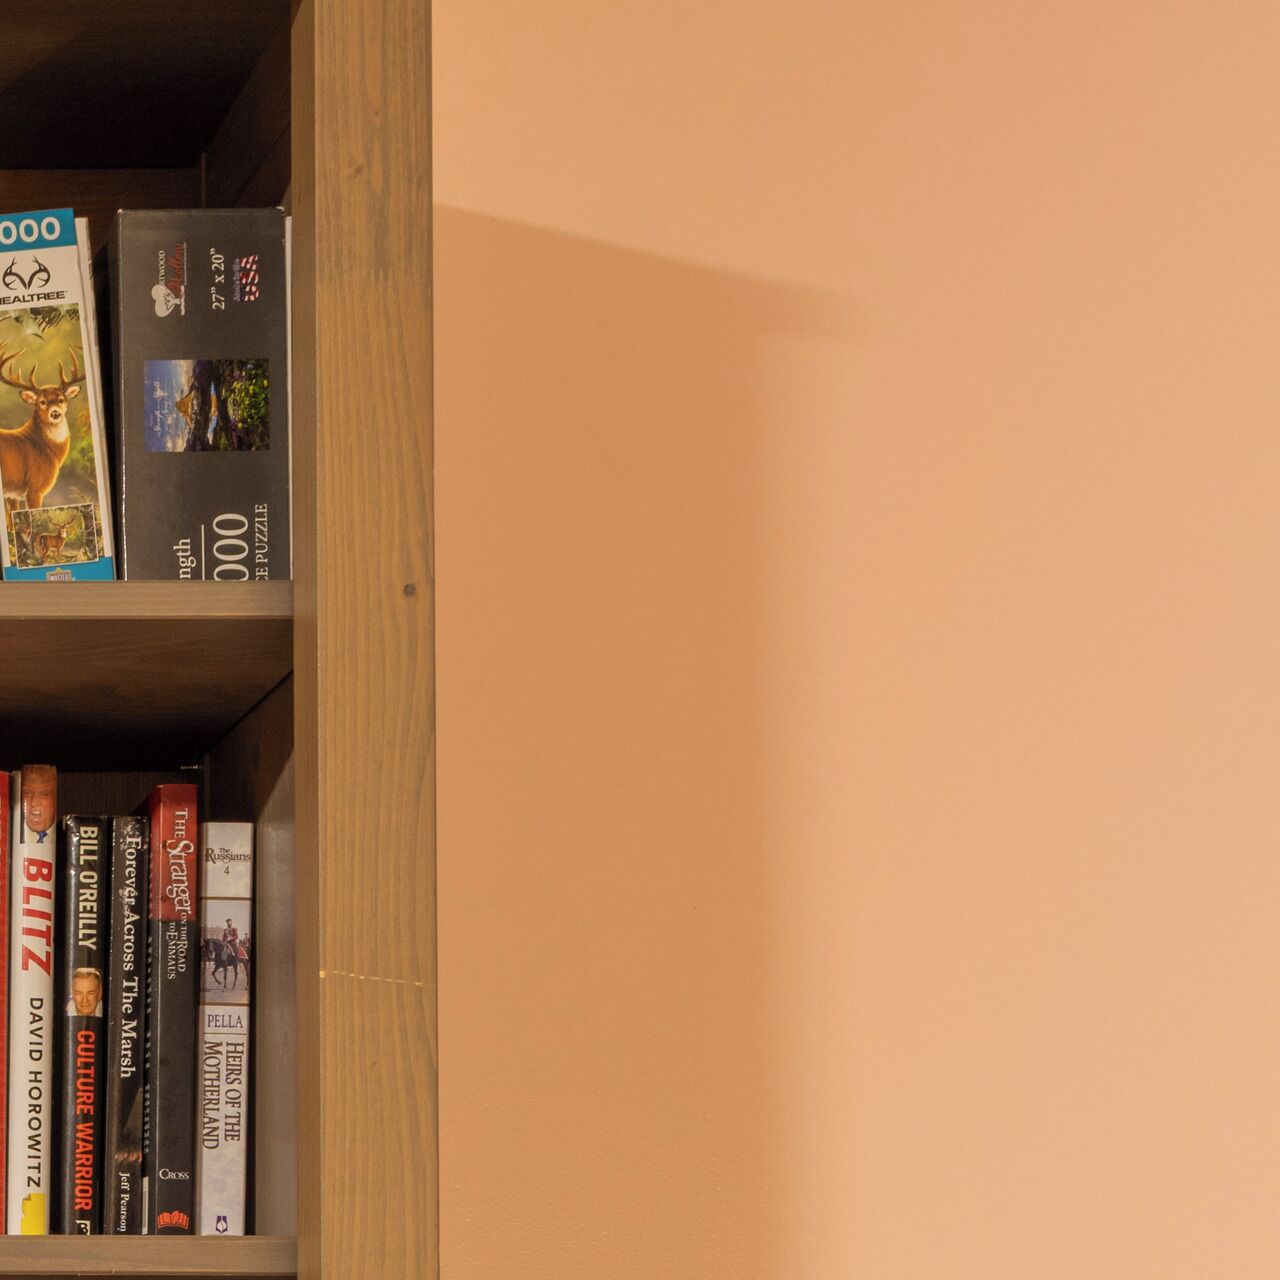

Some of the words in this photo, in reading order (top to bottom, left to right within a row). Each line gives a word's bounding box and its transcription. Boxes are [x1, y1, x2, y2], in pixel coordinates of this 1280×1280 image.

[254, 504, 268, 563] PUZZLE
[80, 826, 98, 865] BILL
[125, 836, 142, 905] Forever
[166, 840, 194, 913] Stranger
[22, 857, 53, 976] BLITZ
[78, 871, 98, 950] O'REILLY
[123, 910, 140, 970] Across
[122, 976, 138, 1014] The
[207, 1014, 244, 1029] PELLA
[29, 998, 44, 1062] DAVID
[120, 1020, 137, 1078] Marsh
[76, 1030, 95, 1115] CULTURE
[27, 1071, 43, 1188] HOROWITZ
[75, 1123, 93, 1210] WARRIOR
